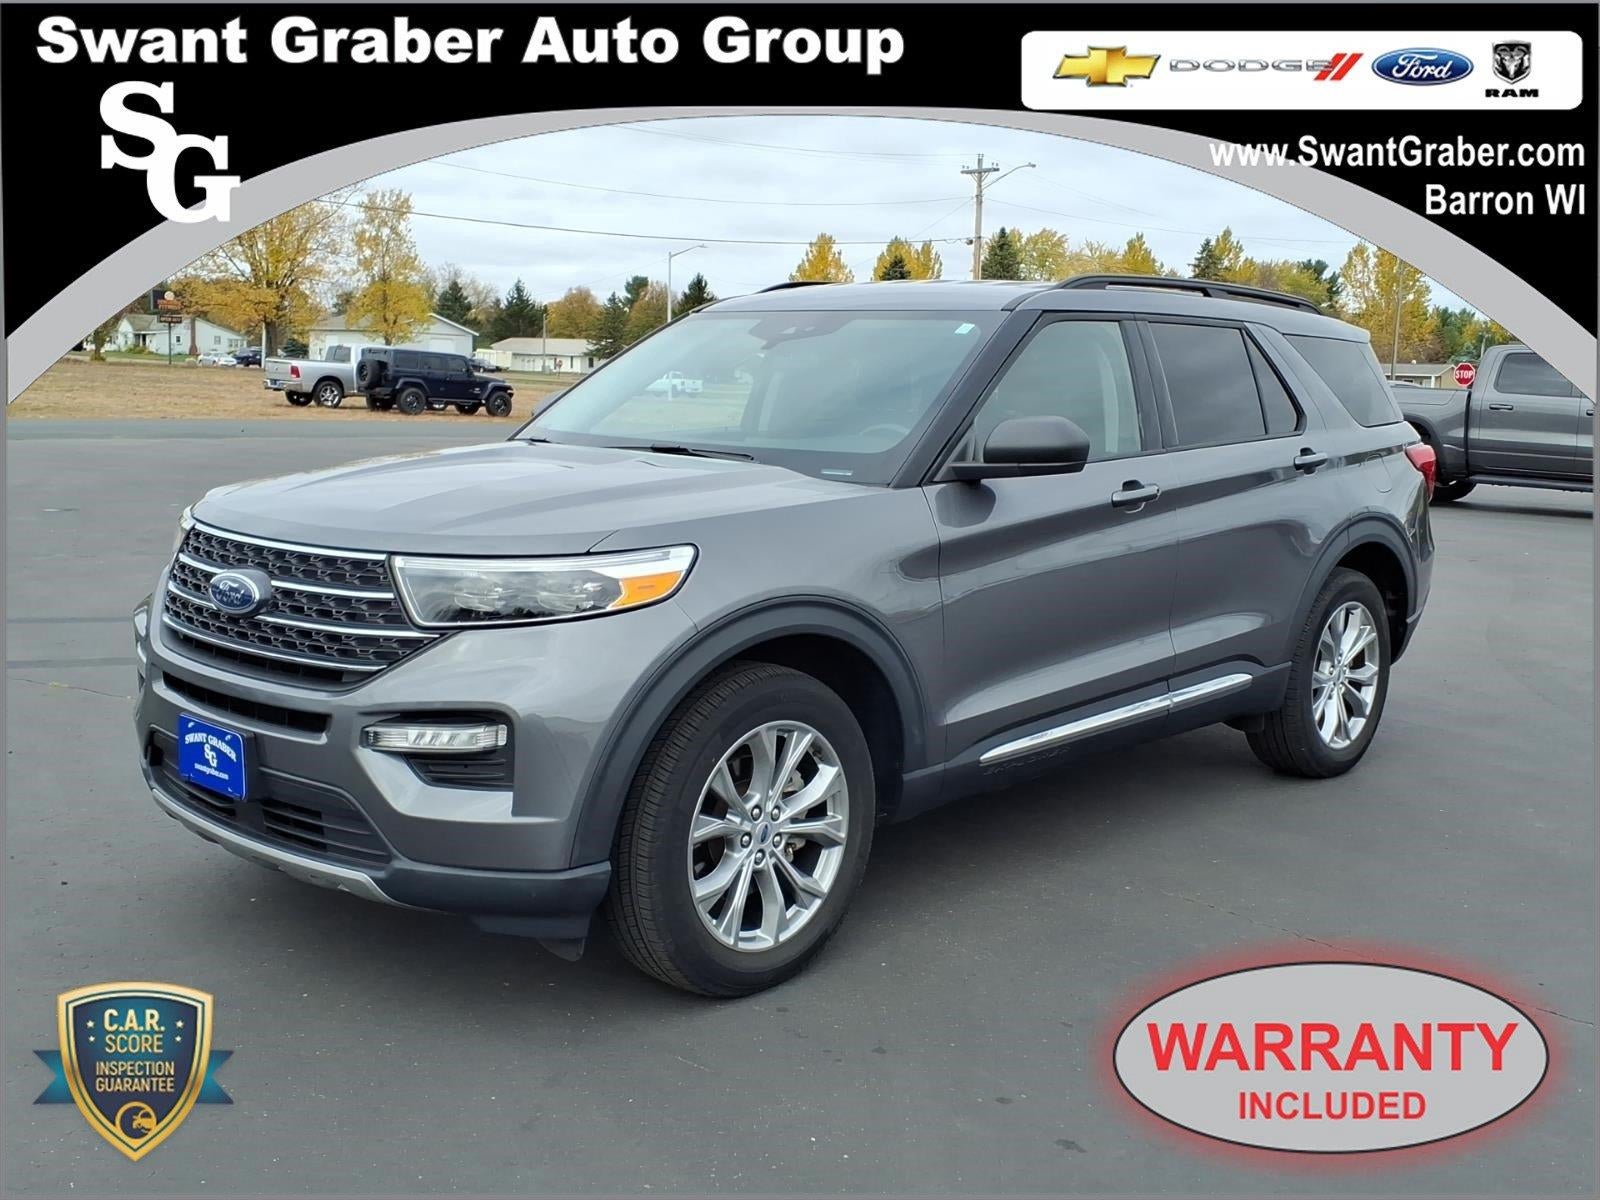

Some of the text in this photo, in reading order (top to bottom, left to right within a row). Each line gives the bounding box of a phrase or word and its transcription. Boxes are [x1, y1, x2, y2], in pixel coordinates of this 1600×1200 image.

[1455, 370, 1474, 379] STOP
[184, 732, 237, 762] SWANT GRABER
